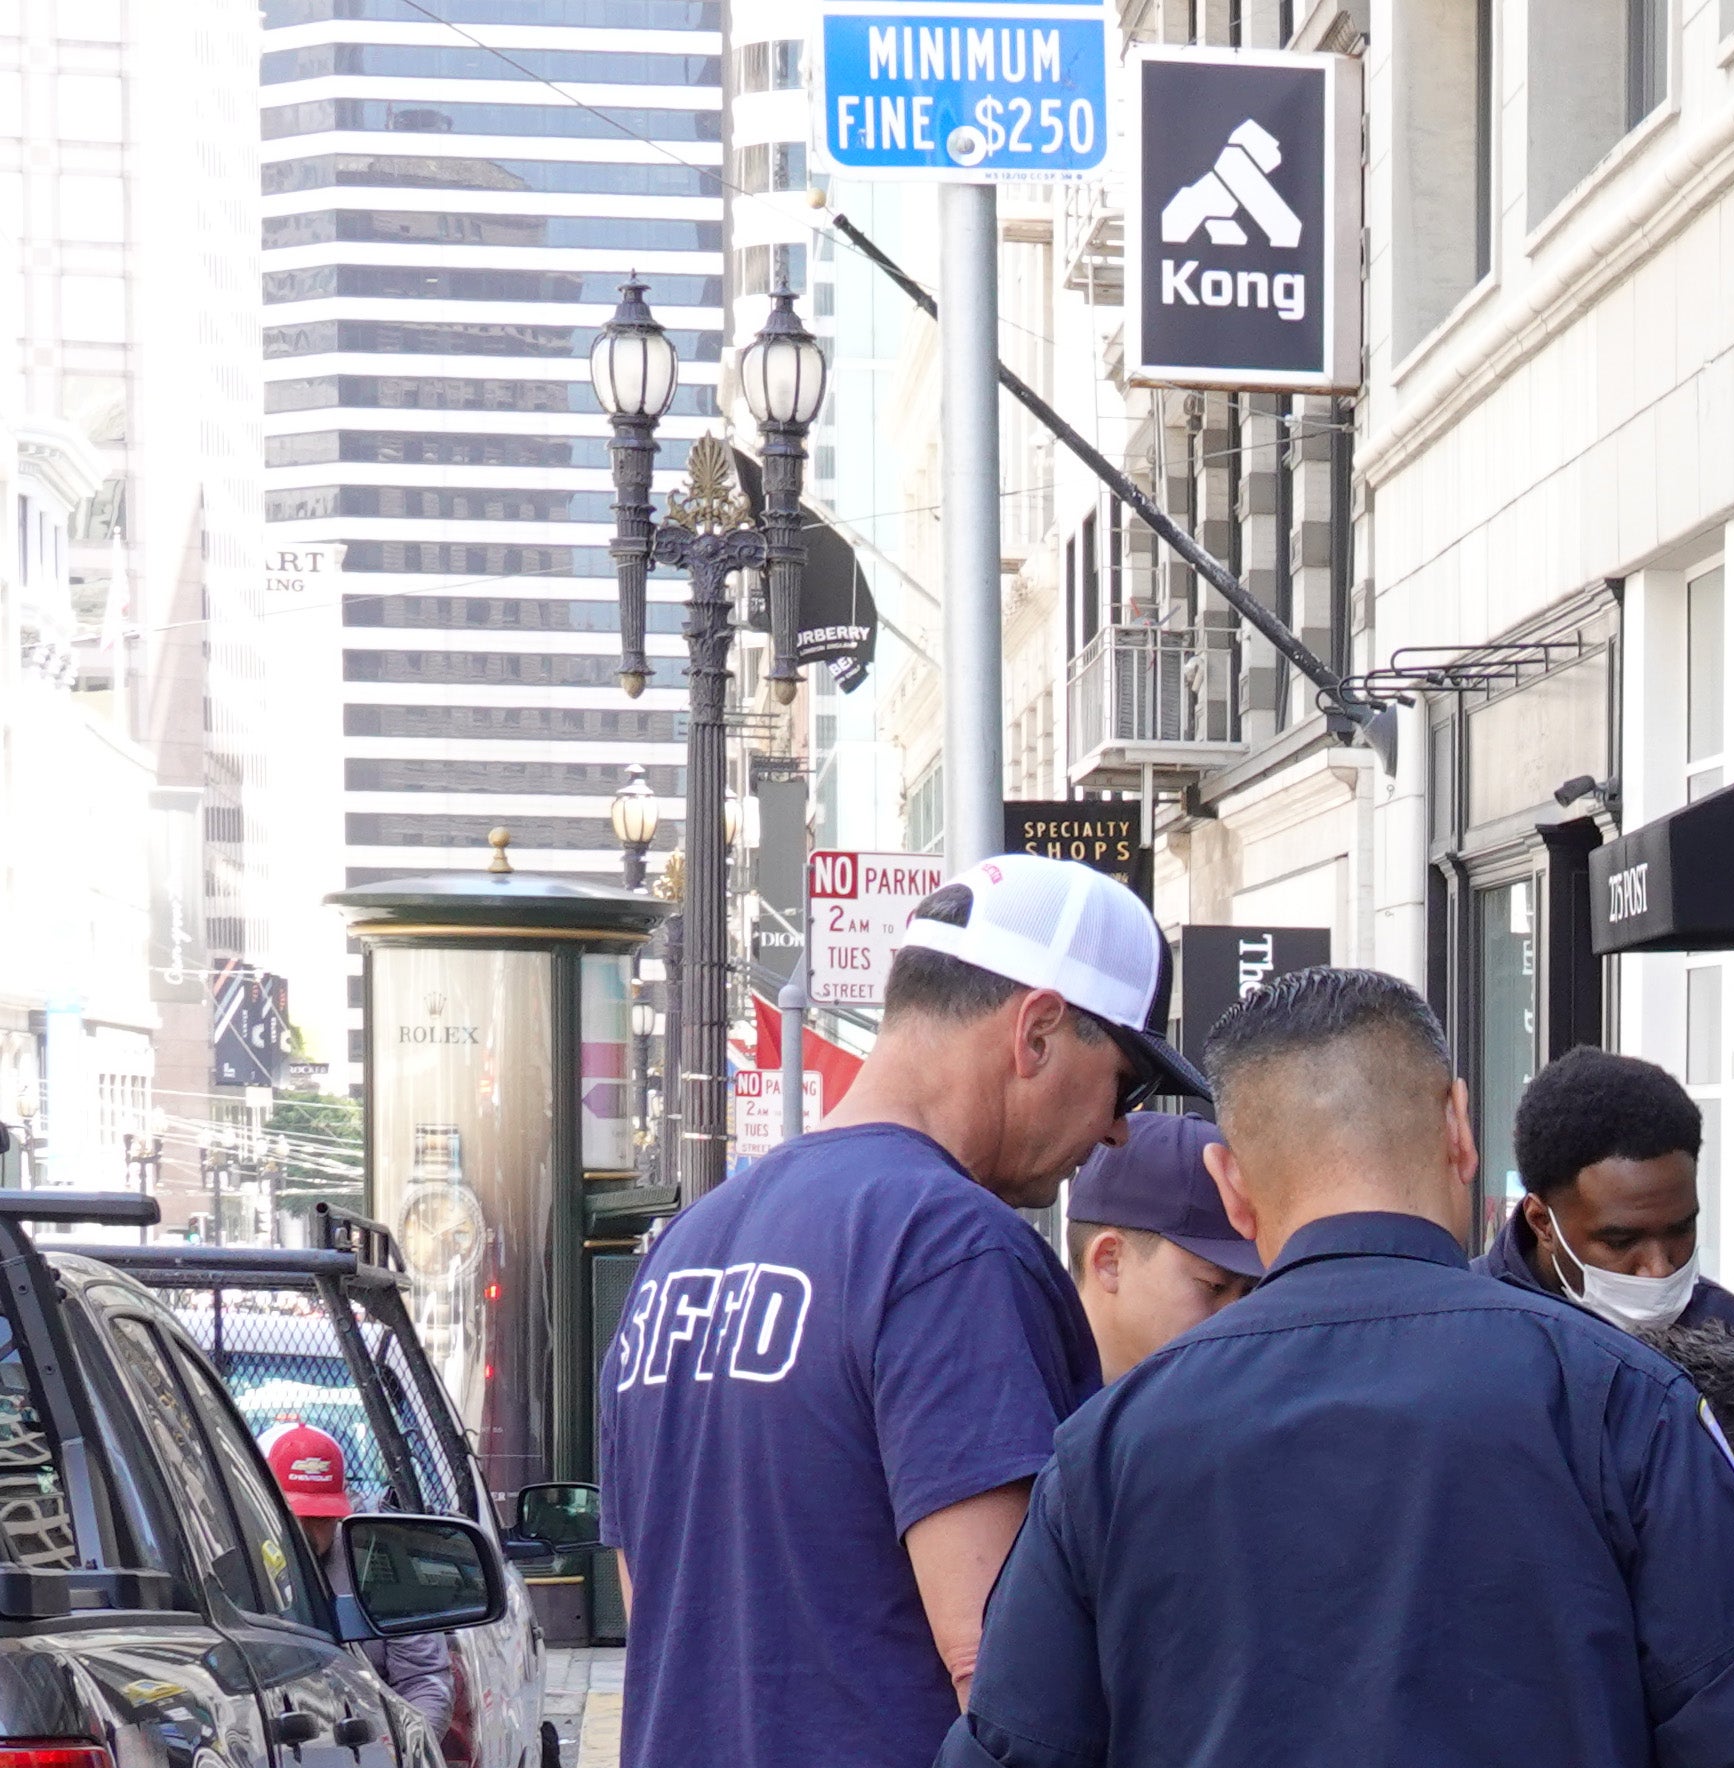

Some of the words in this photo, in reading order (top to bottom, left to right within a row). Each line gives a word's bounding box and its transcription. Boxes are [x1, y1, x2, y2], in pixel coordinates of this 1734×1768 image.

[869, 25, 1060, 82] MINIMUM
[837, 95, 935, 149] FINE
[974, 94, 1094, 157] $250
[1161, 259, 1305, 321] Kong
[1023, 821, 1130, 839] SPECIALTY
[1024, 840, 1131, 861] SHOPS
[814, 854, 853, 895] NO
[1623, 862, 1649, 919] POST
[827, 946, 872, 970] TUES
[822, 982, 875, 999] STREET
[398, 1025, 480, 1045] ROLEX
[737, 1072, 760, 1094] NO
[765, 1079, 817, 1096] PANG
[744, 1123, 769, 1138] TUES
